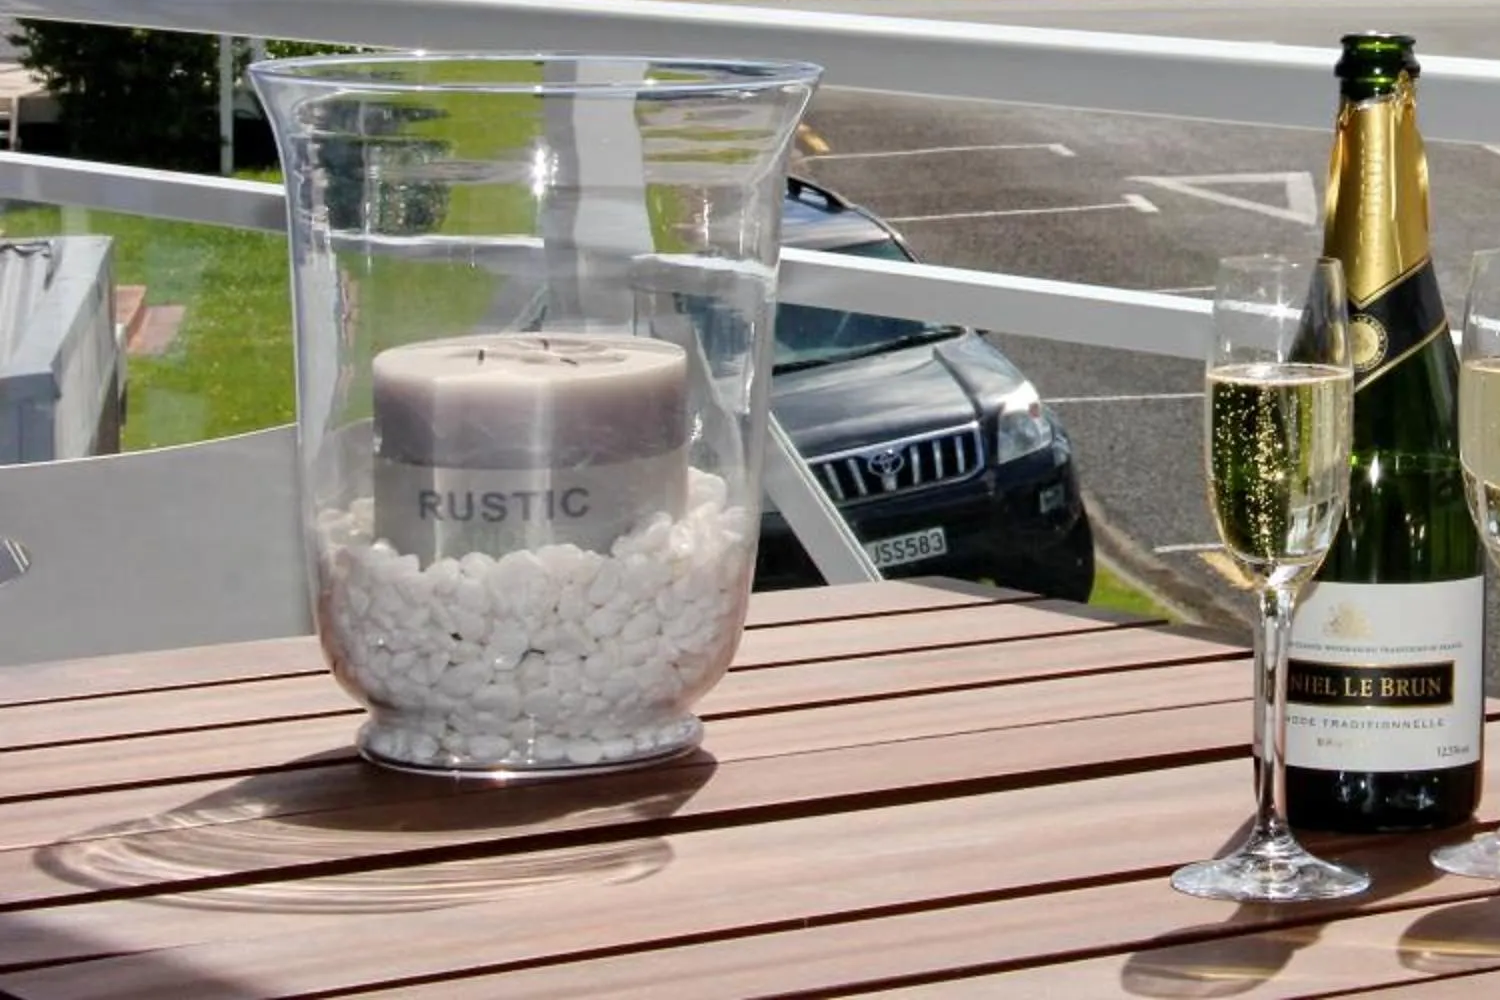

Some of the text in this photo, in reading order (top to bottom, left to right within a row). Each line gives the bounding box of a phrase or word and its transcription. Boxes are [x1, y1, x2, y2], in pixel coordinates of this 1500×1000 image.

[418, 487, 590, 523] RUSTIC
[1289, 673, 1442, 698] NIEL LE BRUN
[1323, 717, 1447, 730] TRADITIONNELLE
